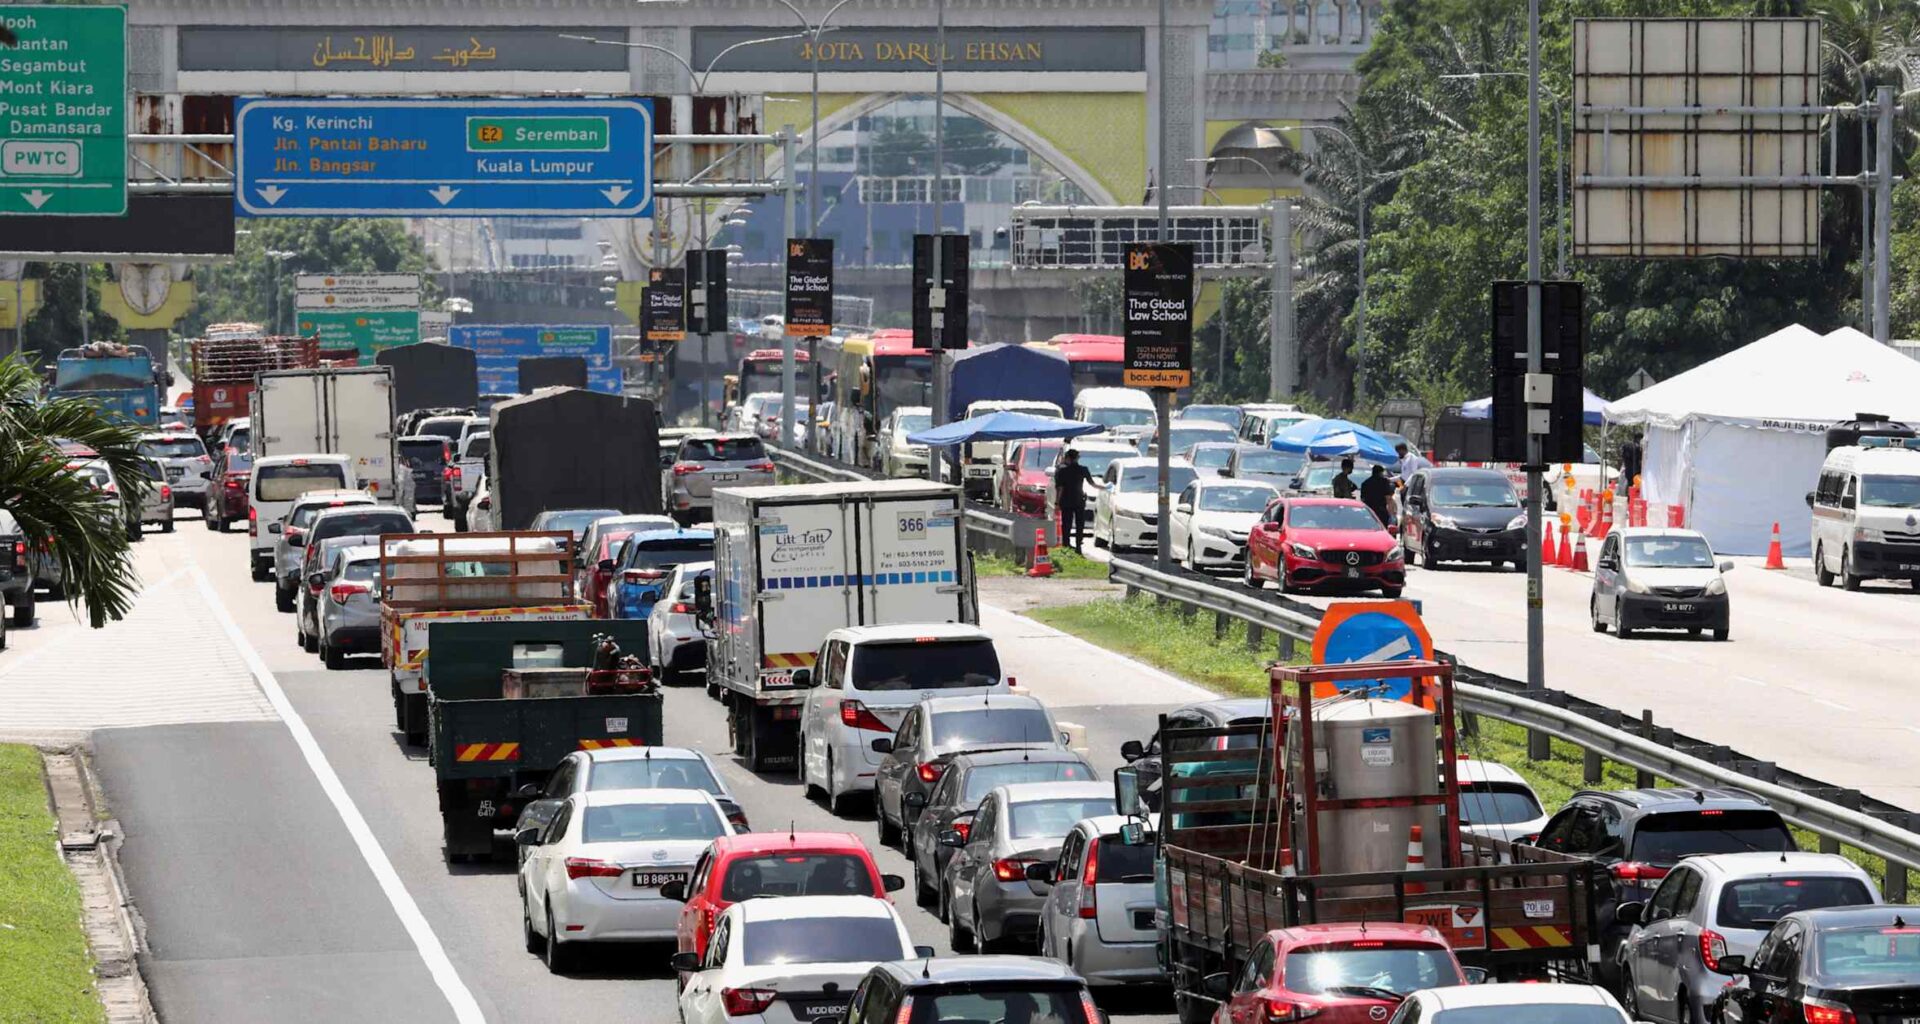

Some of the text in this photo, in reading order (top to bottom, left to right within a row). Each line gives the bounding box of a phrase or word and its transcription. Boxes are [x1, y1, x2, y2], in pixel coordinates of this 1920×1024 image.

[801, 41, 1042, 66] KOTA DARUL EHSAN
[1, 59, 87, 75] Segambut
[0, 81, 94, 95] Mont Kiara
[0, 102, 113, 116] Pusat Bandar
[10, 120, 102, 135] Damansara
[273, 116, 373, 132] Kg. Kerinchi
[481, 127, 598, 142] E2 Seremban
[274, 137, 427, 151] Jln. Pantai Baharu
[15, 151, 67, 165] PWTC
[274, 158, 377, 175] Jln. Bangsar
[476, 159, 594, 176] Kuala Lumpur
[1129, 298, 1185, 310] The Global
[1129, 310, 1187, 321] Law School
[1130, 371, 1184, 384] bac.edu.my
[1762, 420, 1806, 431] MAJLIS
[900, 518, 924, 532] 366
[776, 533, 826, 545] Litt Tatt
[636, 874, 650, 885] WB
[1525, 902, 1535, 911] 70
